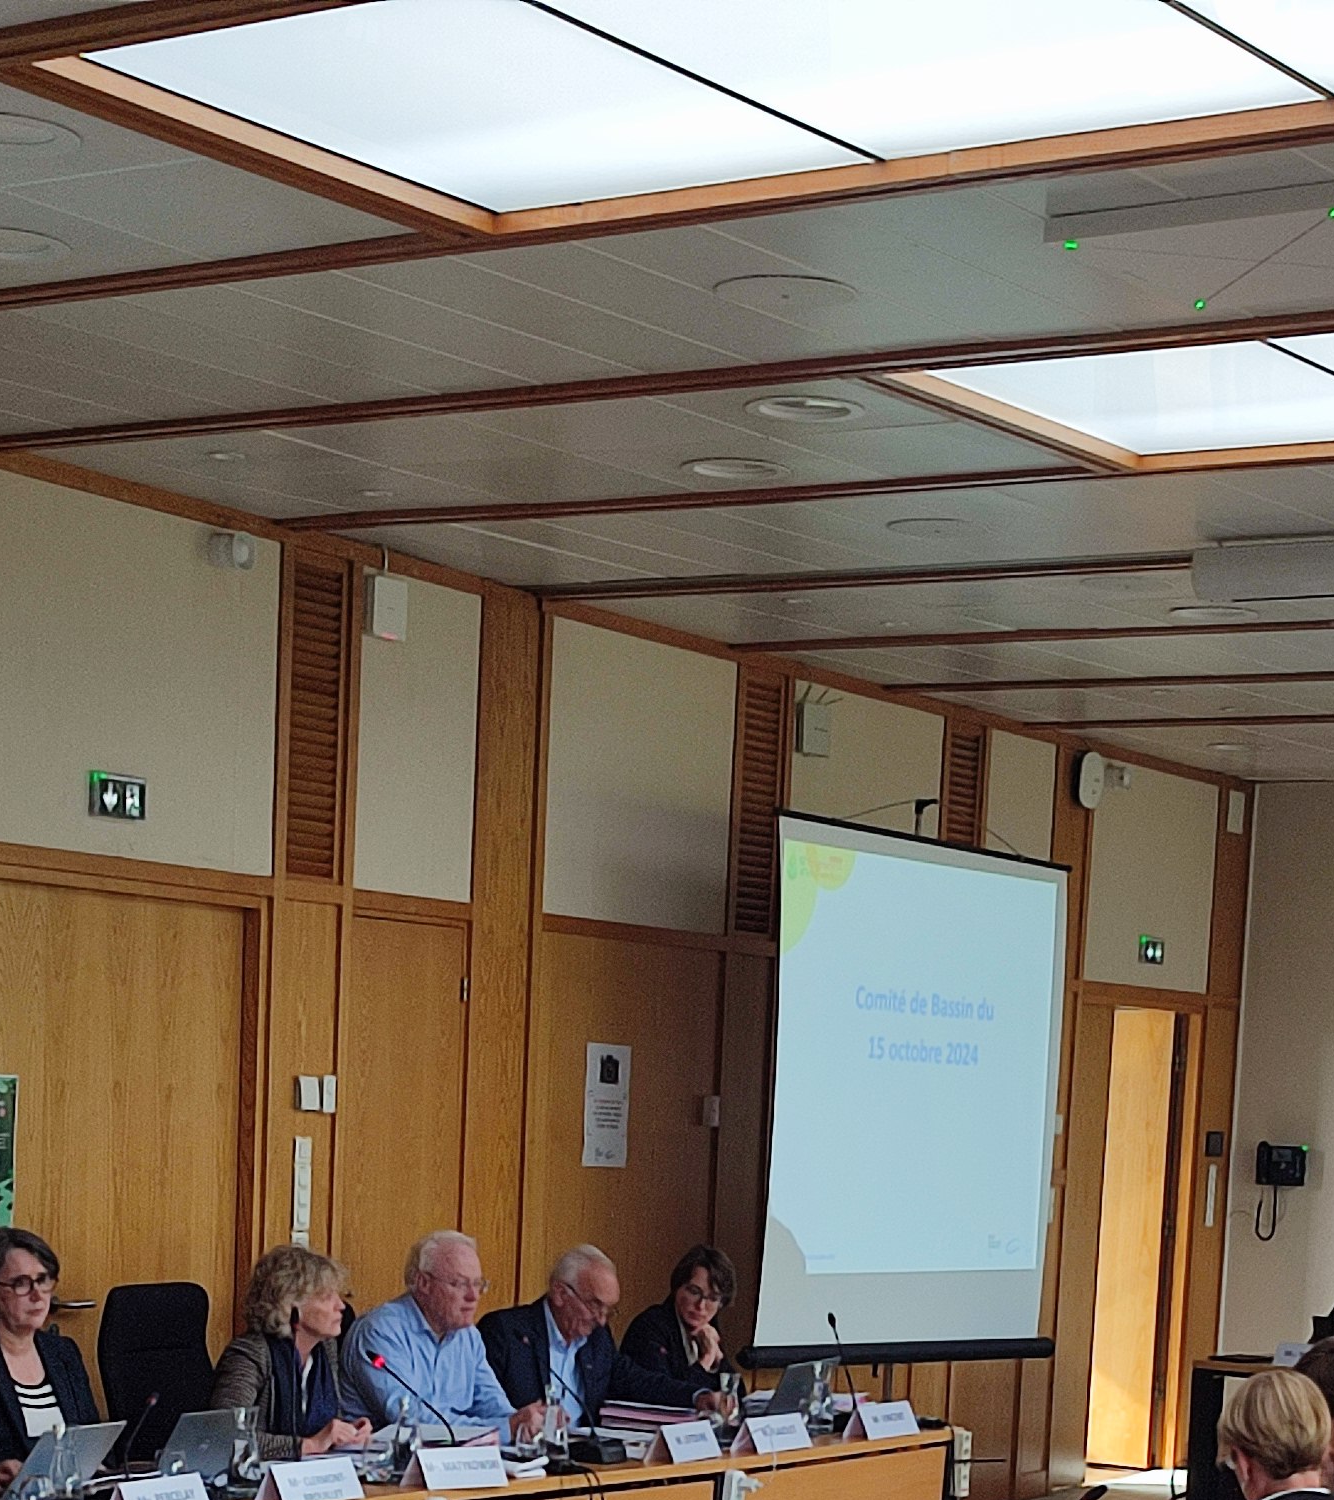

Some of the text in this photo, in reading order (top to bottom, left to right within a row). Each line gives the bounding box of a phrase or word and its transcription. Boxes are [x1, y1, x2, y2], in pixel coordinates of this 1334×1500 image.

[855, 985, 994, 1021] Comité de Bassin du
[869, 1036, 979, 1066] 15 octobre 2024
